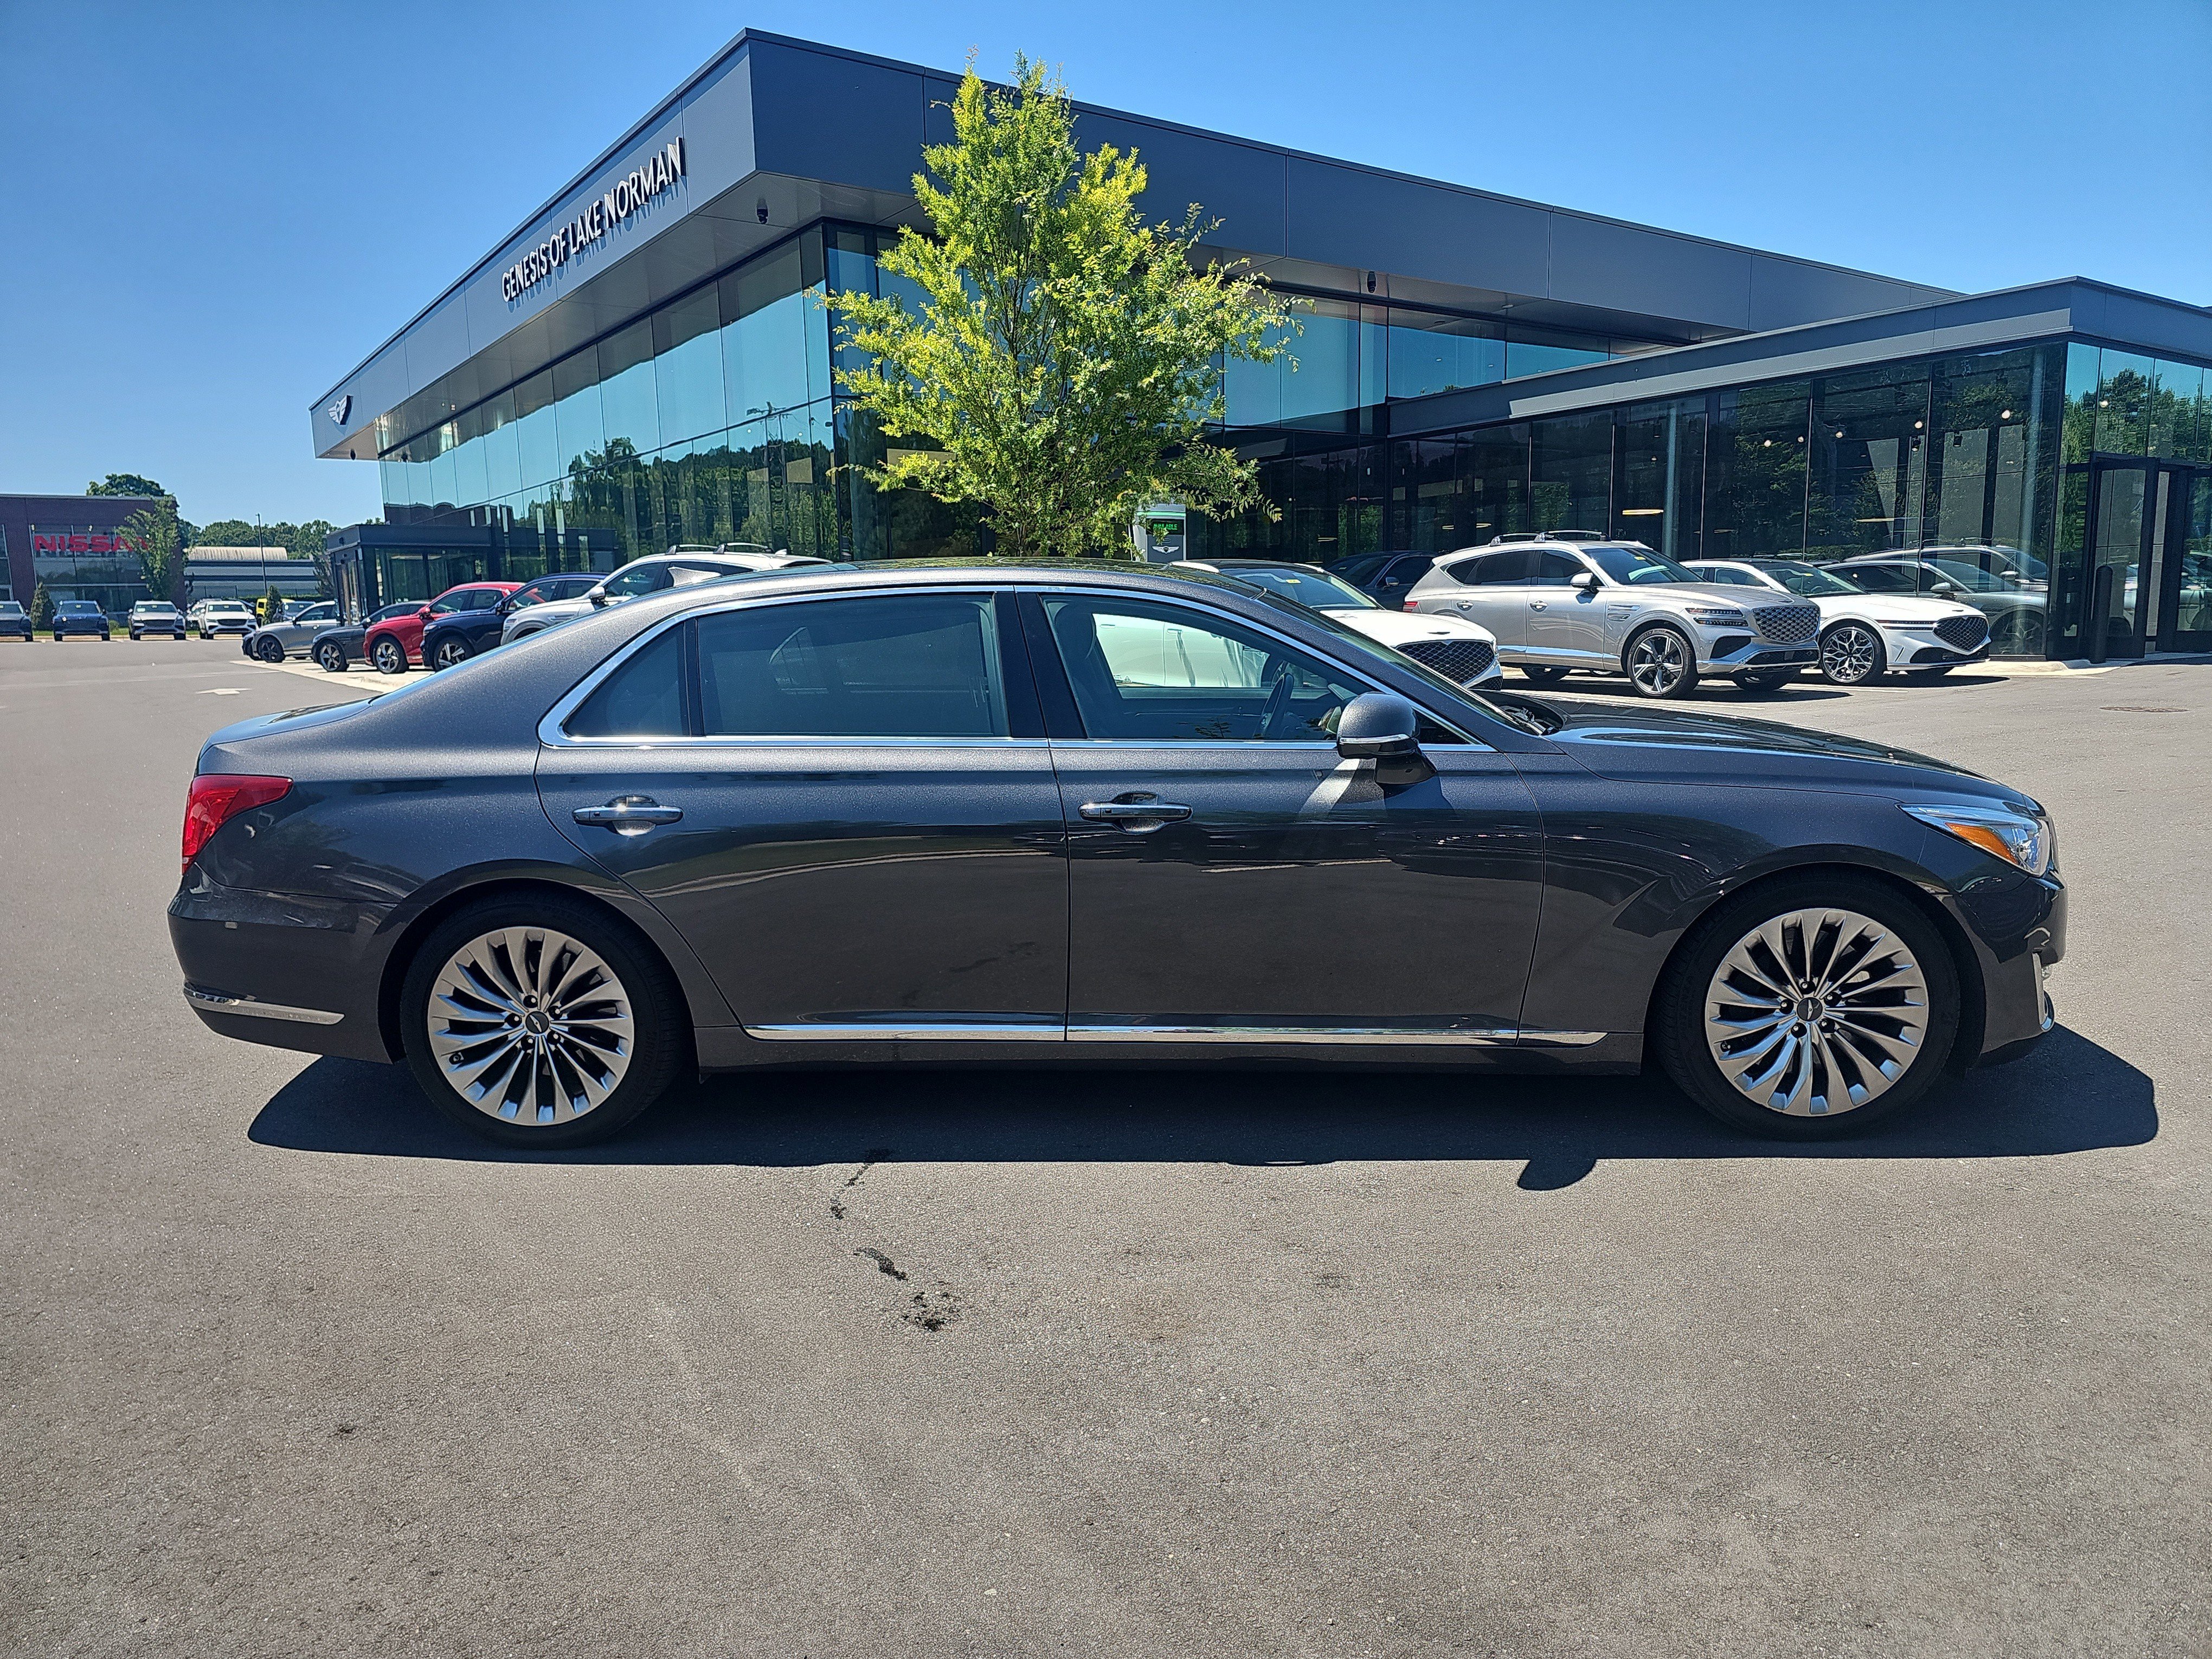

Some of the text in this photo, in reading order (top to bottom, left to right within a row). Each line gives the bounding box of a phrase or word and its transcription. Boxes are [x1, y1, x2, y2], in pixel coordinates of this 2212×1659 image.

[501, 136, 685, 303] GENESIS OF LAKE NORMAN
